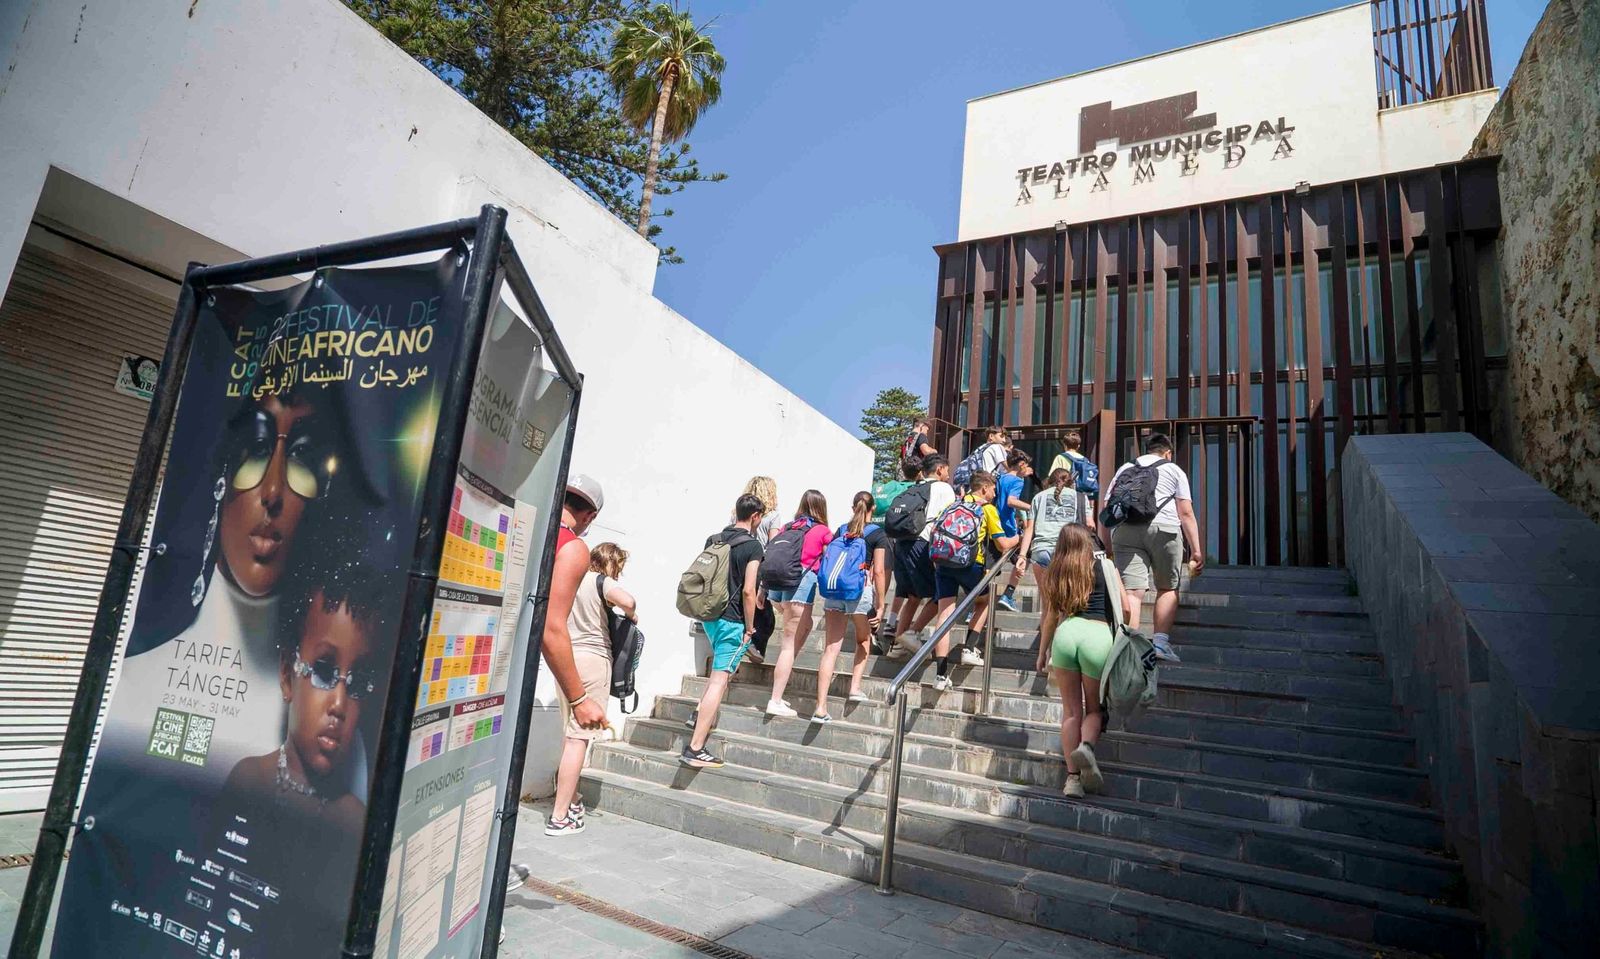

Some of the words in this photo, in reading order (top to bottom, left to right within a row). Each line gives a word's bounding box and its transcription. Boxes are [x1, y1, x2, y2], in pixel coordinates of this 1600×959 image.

[1017, 150, 1117, 184] TEATRO
[1130, 116, 1296, 163] MUNICIPAL
[1015, 135, 1297, 203] ALAMEDA
[284, 303, 399, 338] FESTIVAL
[407, 295, 441, 328] DE
[297, 324, 434, 361] AFRICANO
[226, 325, 254, 398] FCAT
[302, 357, 354, 390] السينما
[359, 359, 429, 389] مهرجان
[174, 639, 243, 671] TARIFA
[167, 664, 249, 703] TÁNGER
[159, 710, 186, 724] FESTIVAL
[162, 692, 175, 705] 23
[179, 696, 199, 711] MAY
[209, 701, 219, 714] 31
[221, 706, 241, 719] MAY
[162, 721, 184, 735] CINE
[150, 738, 180, 757] FCAT
[415, 766, 465, 806] EXTENSIONES
